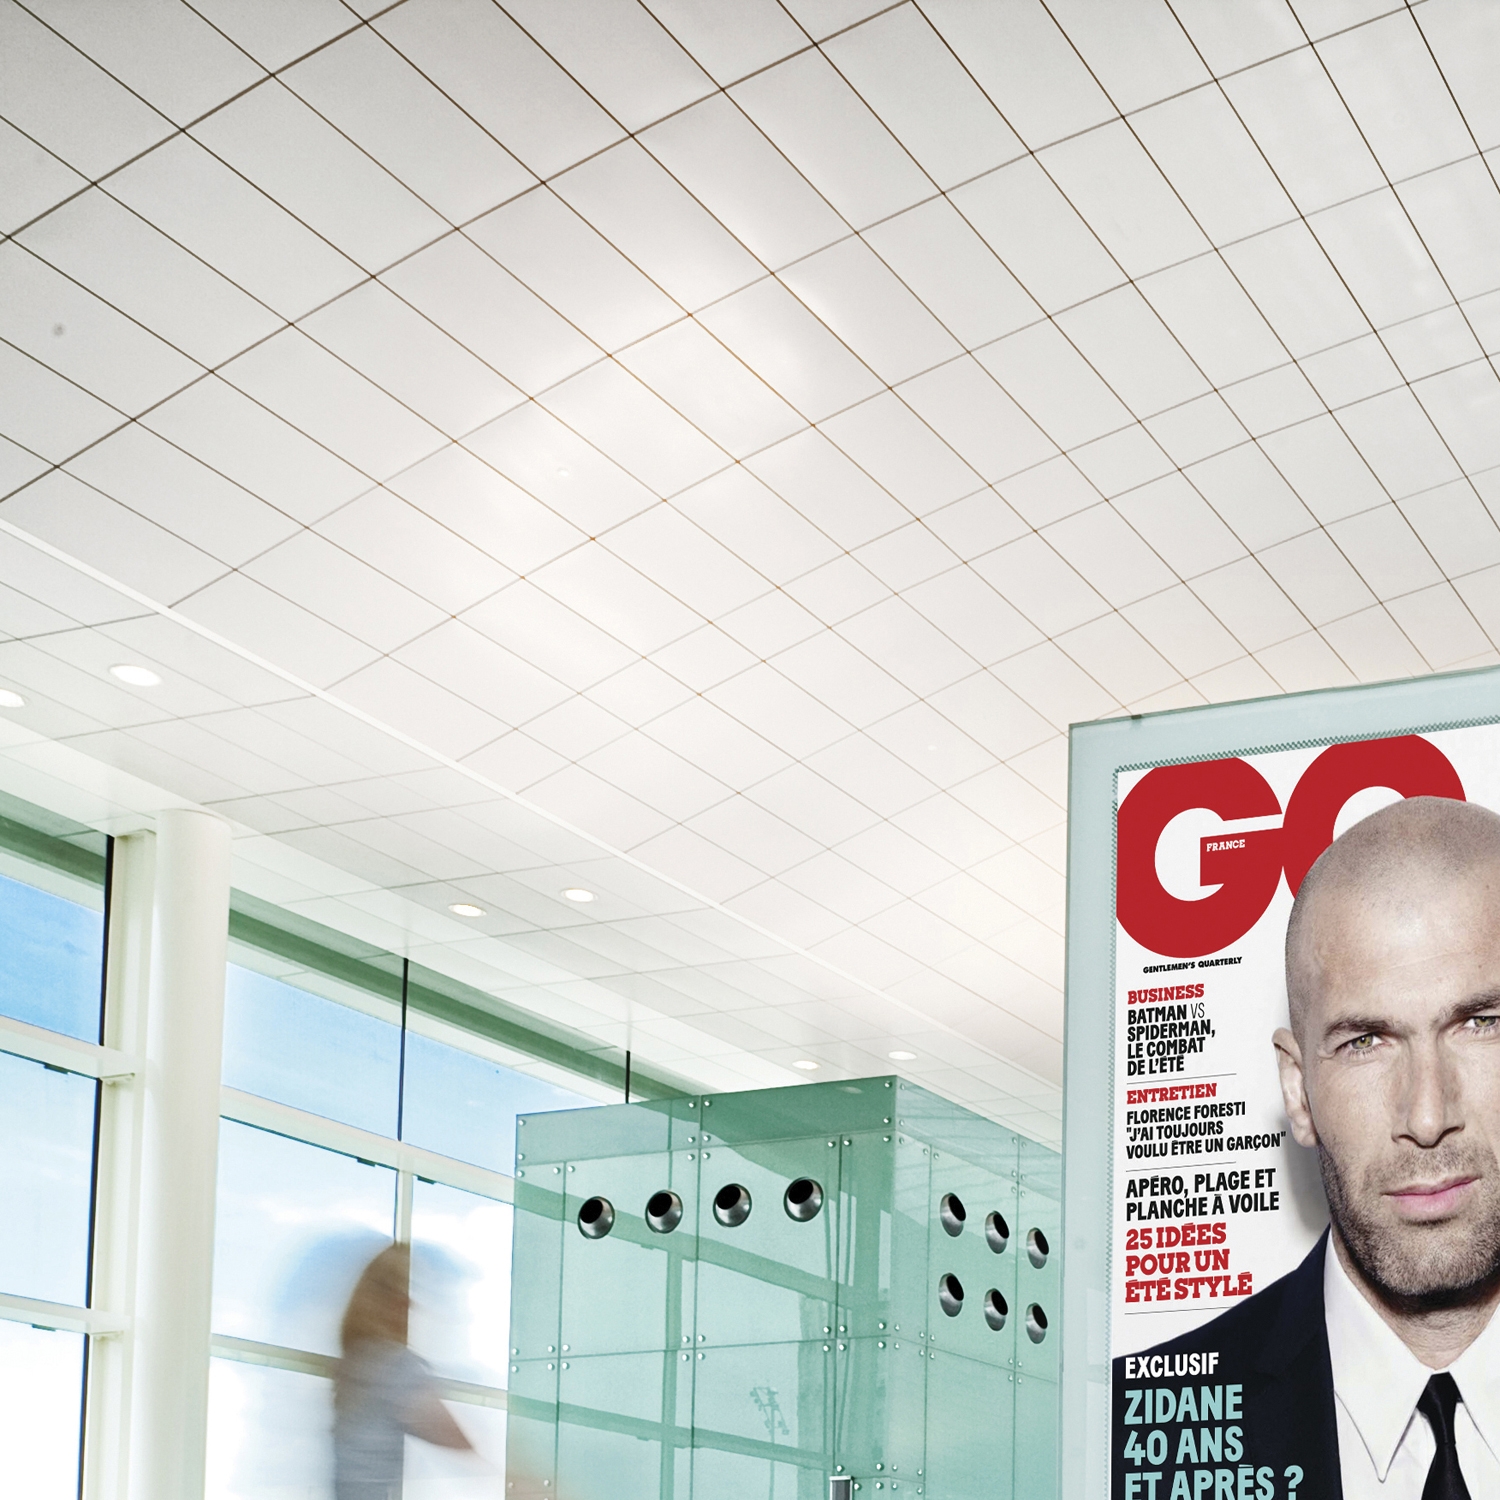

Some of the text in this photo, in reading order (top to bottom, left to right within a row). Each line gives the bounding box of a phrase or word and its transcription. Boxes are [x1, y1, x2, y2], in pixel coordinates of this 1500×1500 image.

[1206, 838, 1246, 852] FRANCE
[1198, 956, 1243, 968] QUARTERLY
[1127, 983, 1204, 1005] BUSINESS
[1128, 1002, 1205, 1025] BATMAN VS
[1127, 1019, 1216, 1042] SPIDERMAN,
[1128, 1036, 1206, 1059] LE COMBAT
[1127, 1059, 1145, 1076] DE
[1127, 1082, 1217, 1105] ENTRETIEN
[1127, 1101, 1246, 1125] FLORENCE FORESTI
[1156, 1120, 1224, 1140] TOUJOURS
[1126, 1142, 1168, 1159] VOULU
[1205, 1138, 1223, 1152] UN
[1126, 1168, 1276, 1199] APÉRO, PLAGE ET
[1126, 1197, 1207, 1221] PLANCHE
[1229, 1191, 1279, 1214] VOILE
[1126, 1222, 1227, 1250] 25 IDÉES
[1126, 1248, 1230, 1276] POUR UN
[1126, 1271, 1253, 1303] ÉTÉ STYLÉ
[1125, 1352, 1219, 1379] EXCLUSIF
[1124, 1383, 1243, 1425] ZIDANE
[1123, 1425, 1244, 1466] 40 ANS
